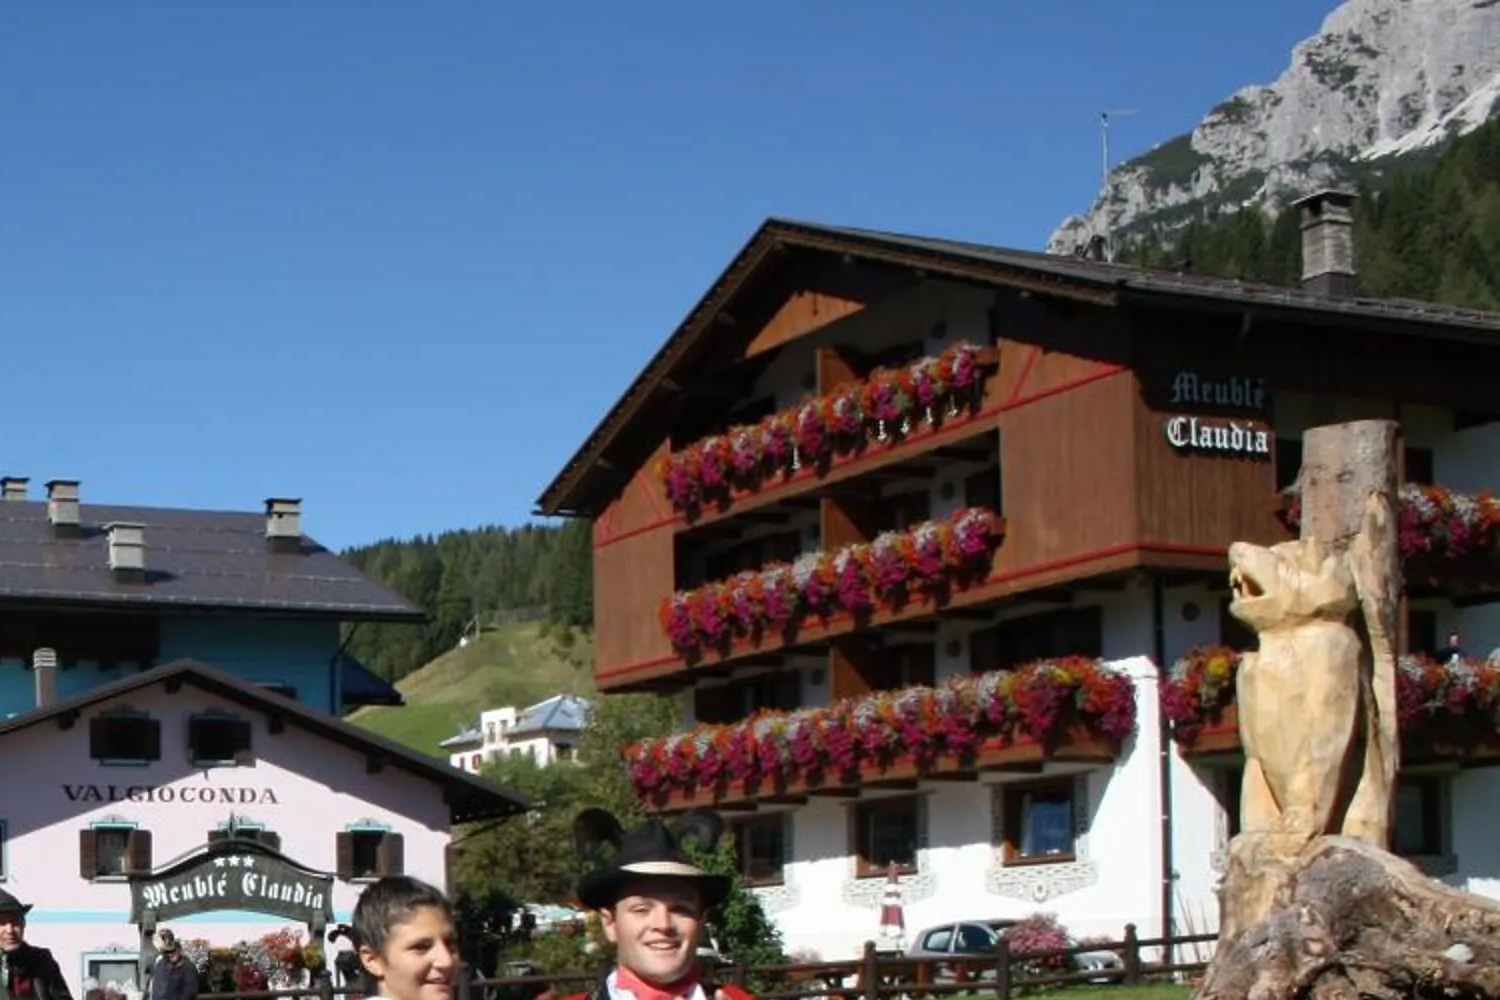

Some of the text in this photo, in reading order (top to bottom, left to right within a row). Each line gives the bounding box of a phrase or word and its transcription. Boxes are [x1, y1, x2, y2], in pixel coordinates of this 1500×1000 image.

[1169, 371, 1265, 409] Meublé
[1167, 415, 1269, 453] Claudia
[61, 784, 280, 805] VALGIOCONDA
[143, 872, 324, 909] Meublé Claudia
